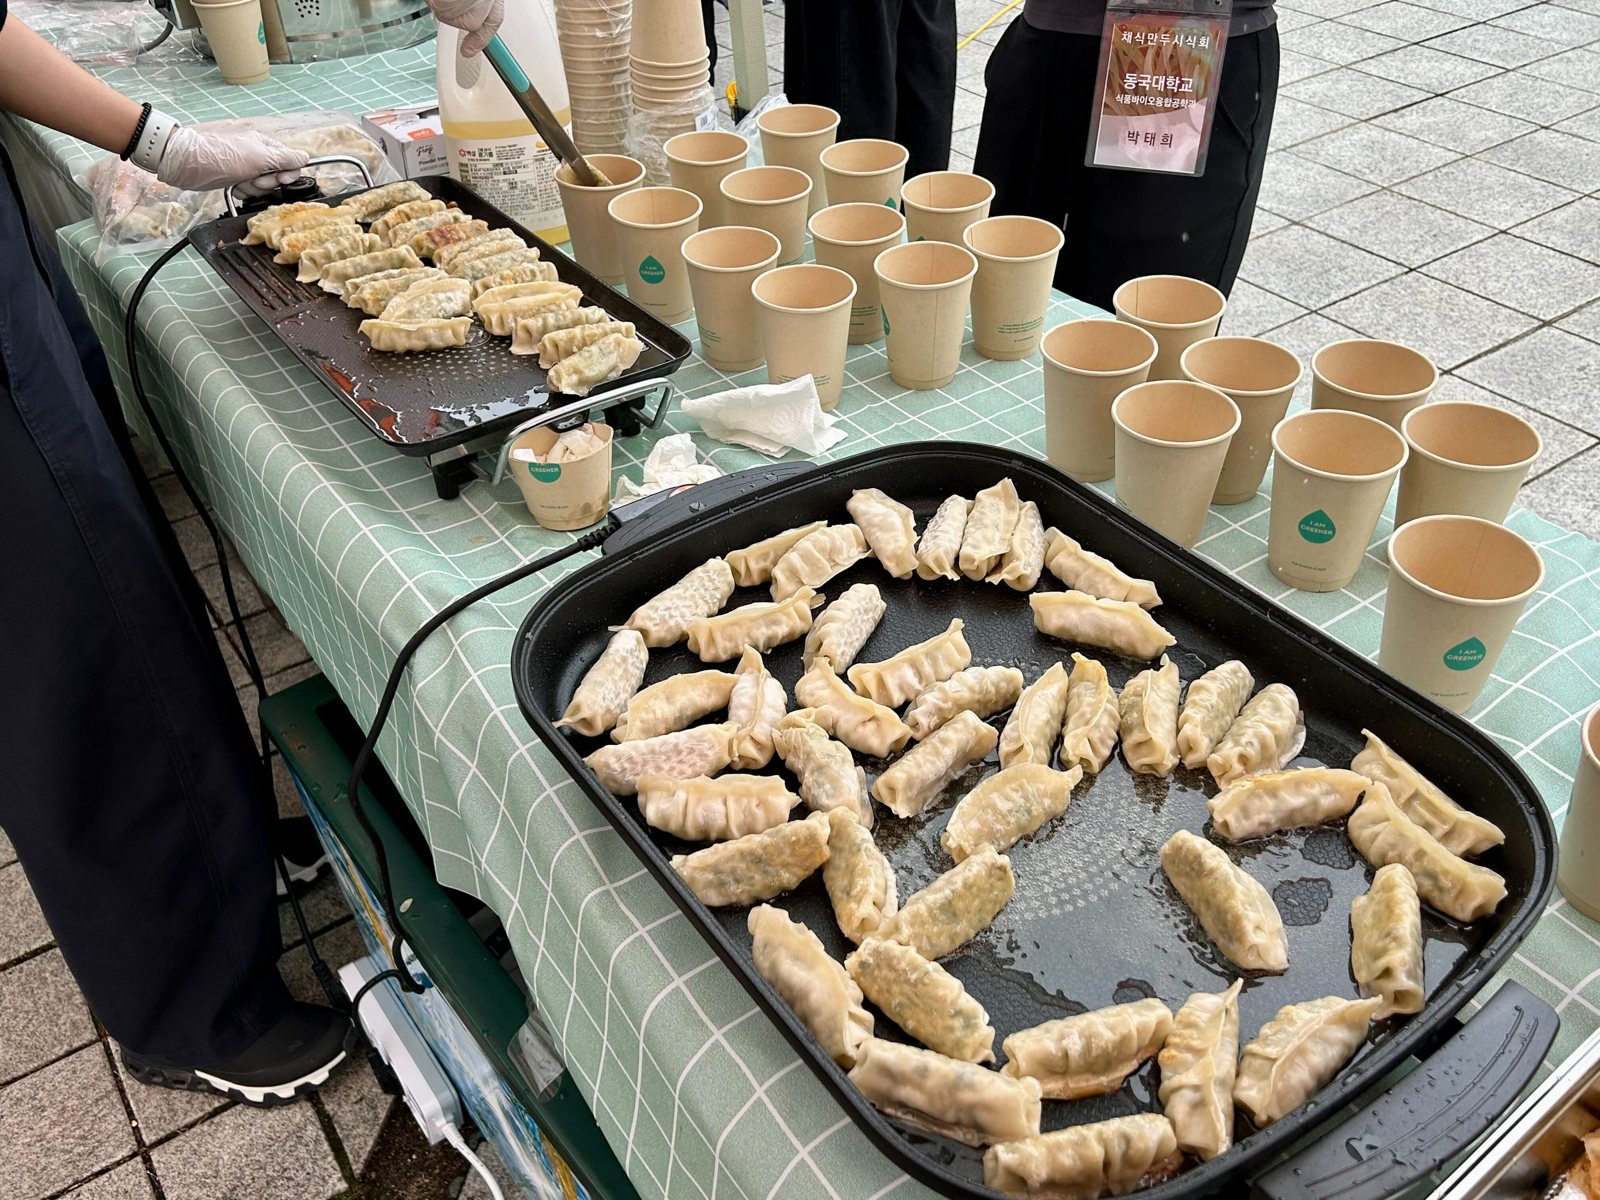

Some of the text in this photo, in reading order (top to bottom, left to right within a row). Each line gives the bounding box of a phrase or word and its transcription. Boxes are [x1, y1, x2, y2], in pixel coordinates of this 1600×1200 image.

[1121, 31, 1210, 49] 채식만두시식회
[1123, 73, 1193, 93] 동국대학교
[1115, 93, 1197, 109] 식품바이오융합공학과
[1127, 130, 1173, 148] 박태희
[418, 158, 436, 166] Powder
[1300, 524, 1333, 536] GREENER
